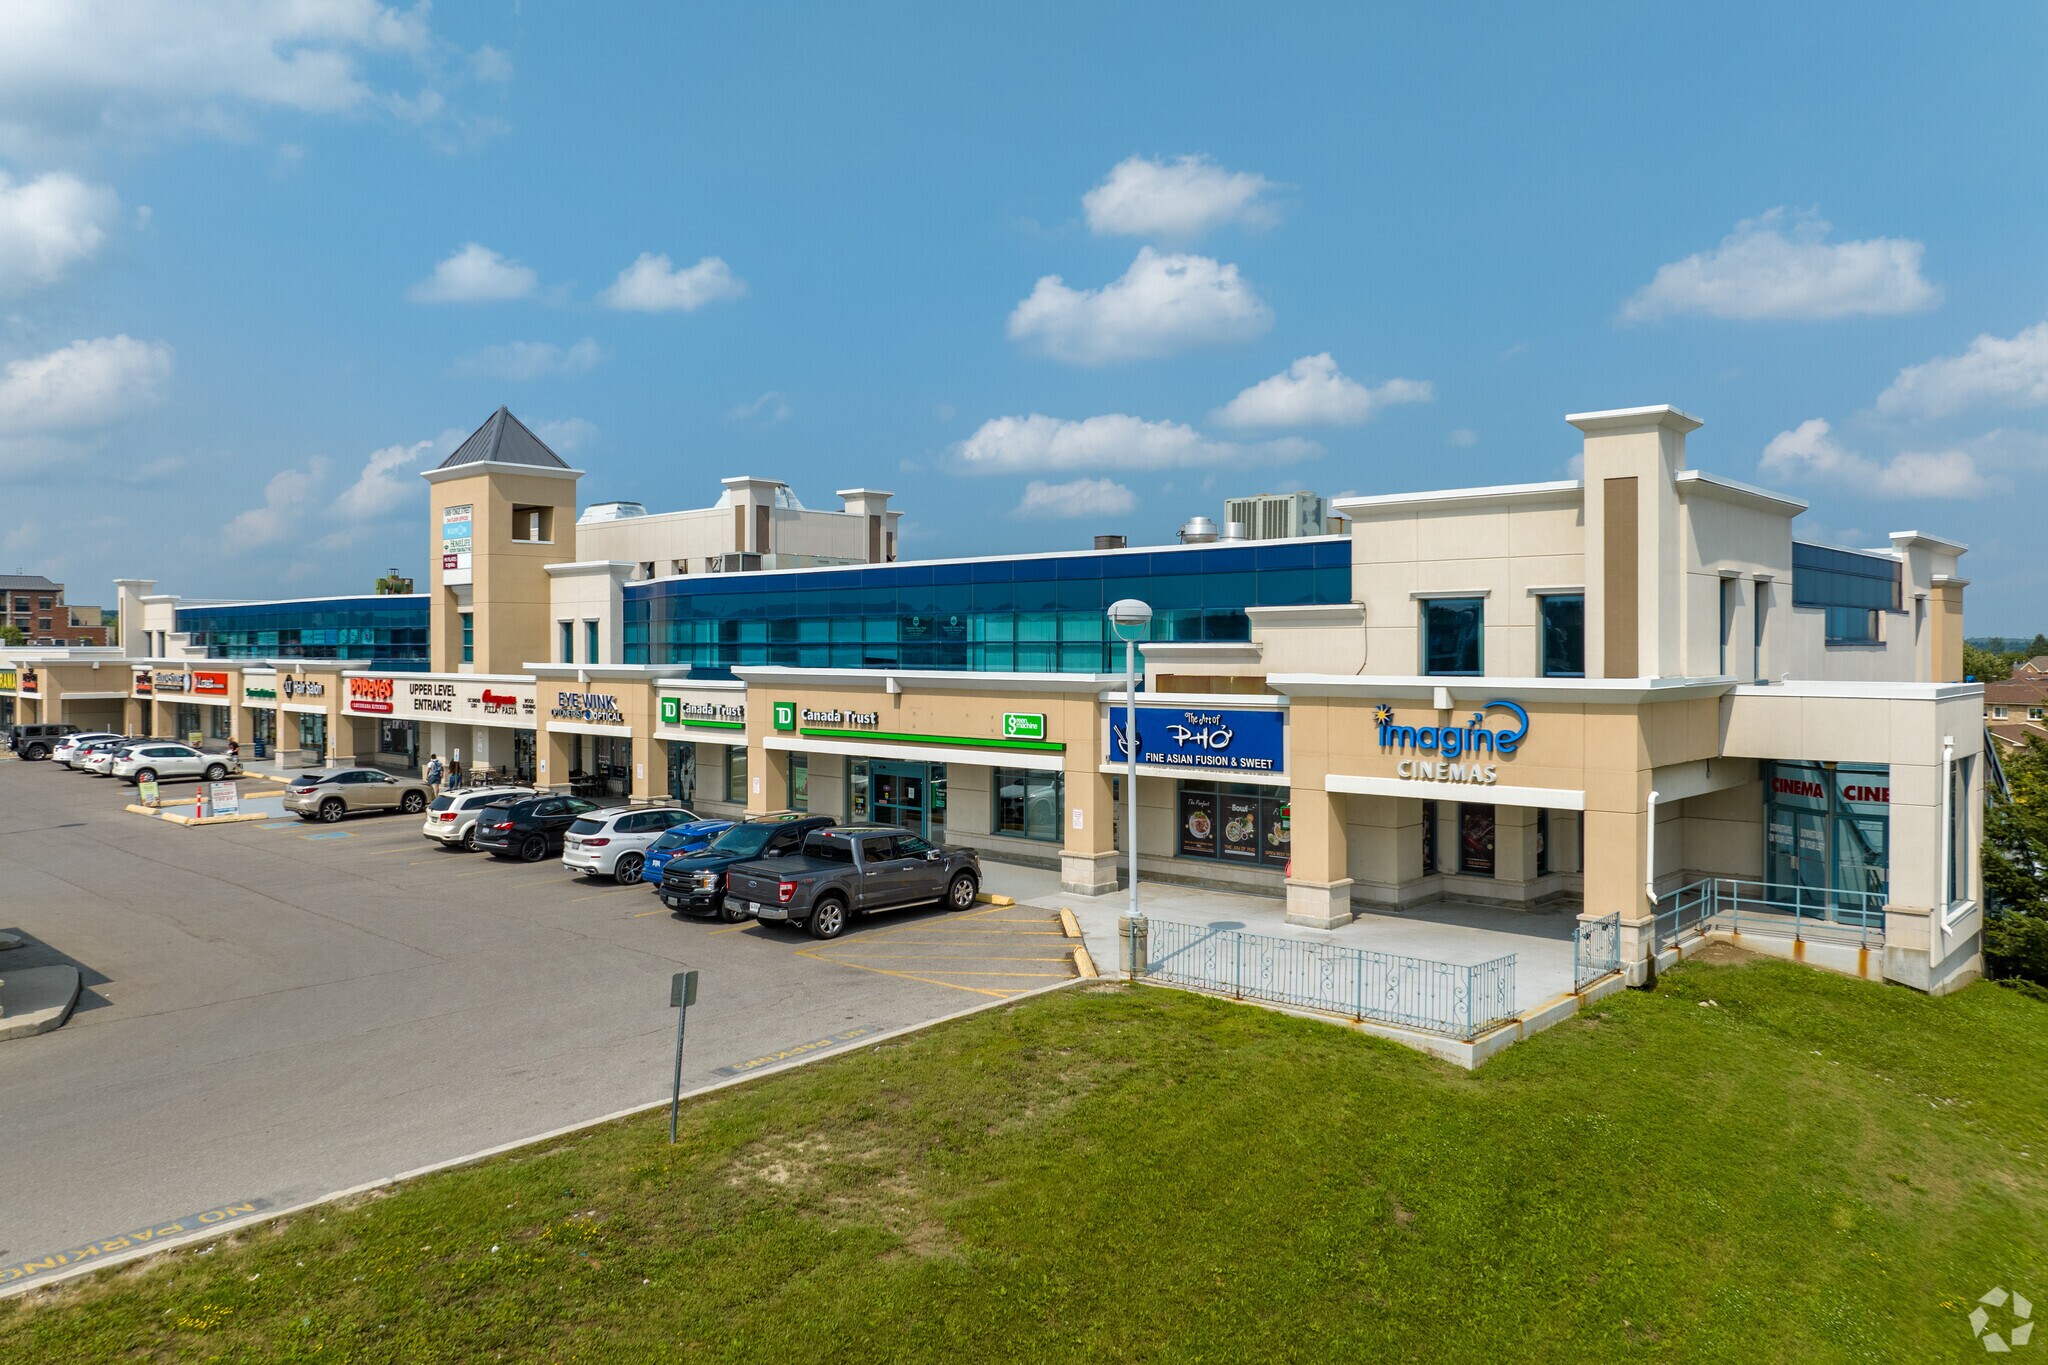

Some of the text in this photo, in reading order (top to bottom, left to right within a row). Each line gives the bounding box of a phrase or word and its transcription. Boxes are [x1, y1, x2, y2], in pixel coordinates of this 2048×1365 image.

[293, 681, 324, 695] Hair Salon
[350, 678, 393, 699] POPEYES
[410, 683, 457, 697] UPPER LEVEL
[414, 699, 452, 712] ENTRANCE
[558, 692, 616, 710] EYE WINK
[484, 705, 517, 715] PIZZA PASTA
[594, 712, 622, 721] OPTICAL
[663, 702, 742, 717] TD Canada Trust
[775, 707, 876, 724] TD Canada Trust
[1184, 712, 1221, 726] The Art of
[1379, 700, 1529, 758] imagine
[1145, 752, 1273, 769] FINE ASIAN FUSION & SWEET
[1397, 759, 1497, 784] CINEMAS
[1771, 777, 1824, 799] CINEMA
[1231, 804, 1248, 813] Bowl
[198, 1202, 256, 1224] NO
